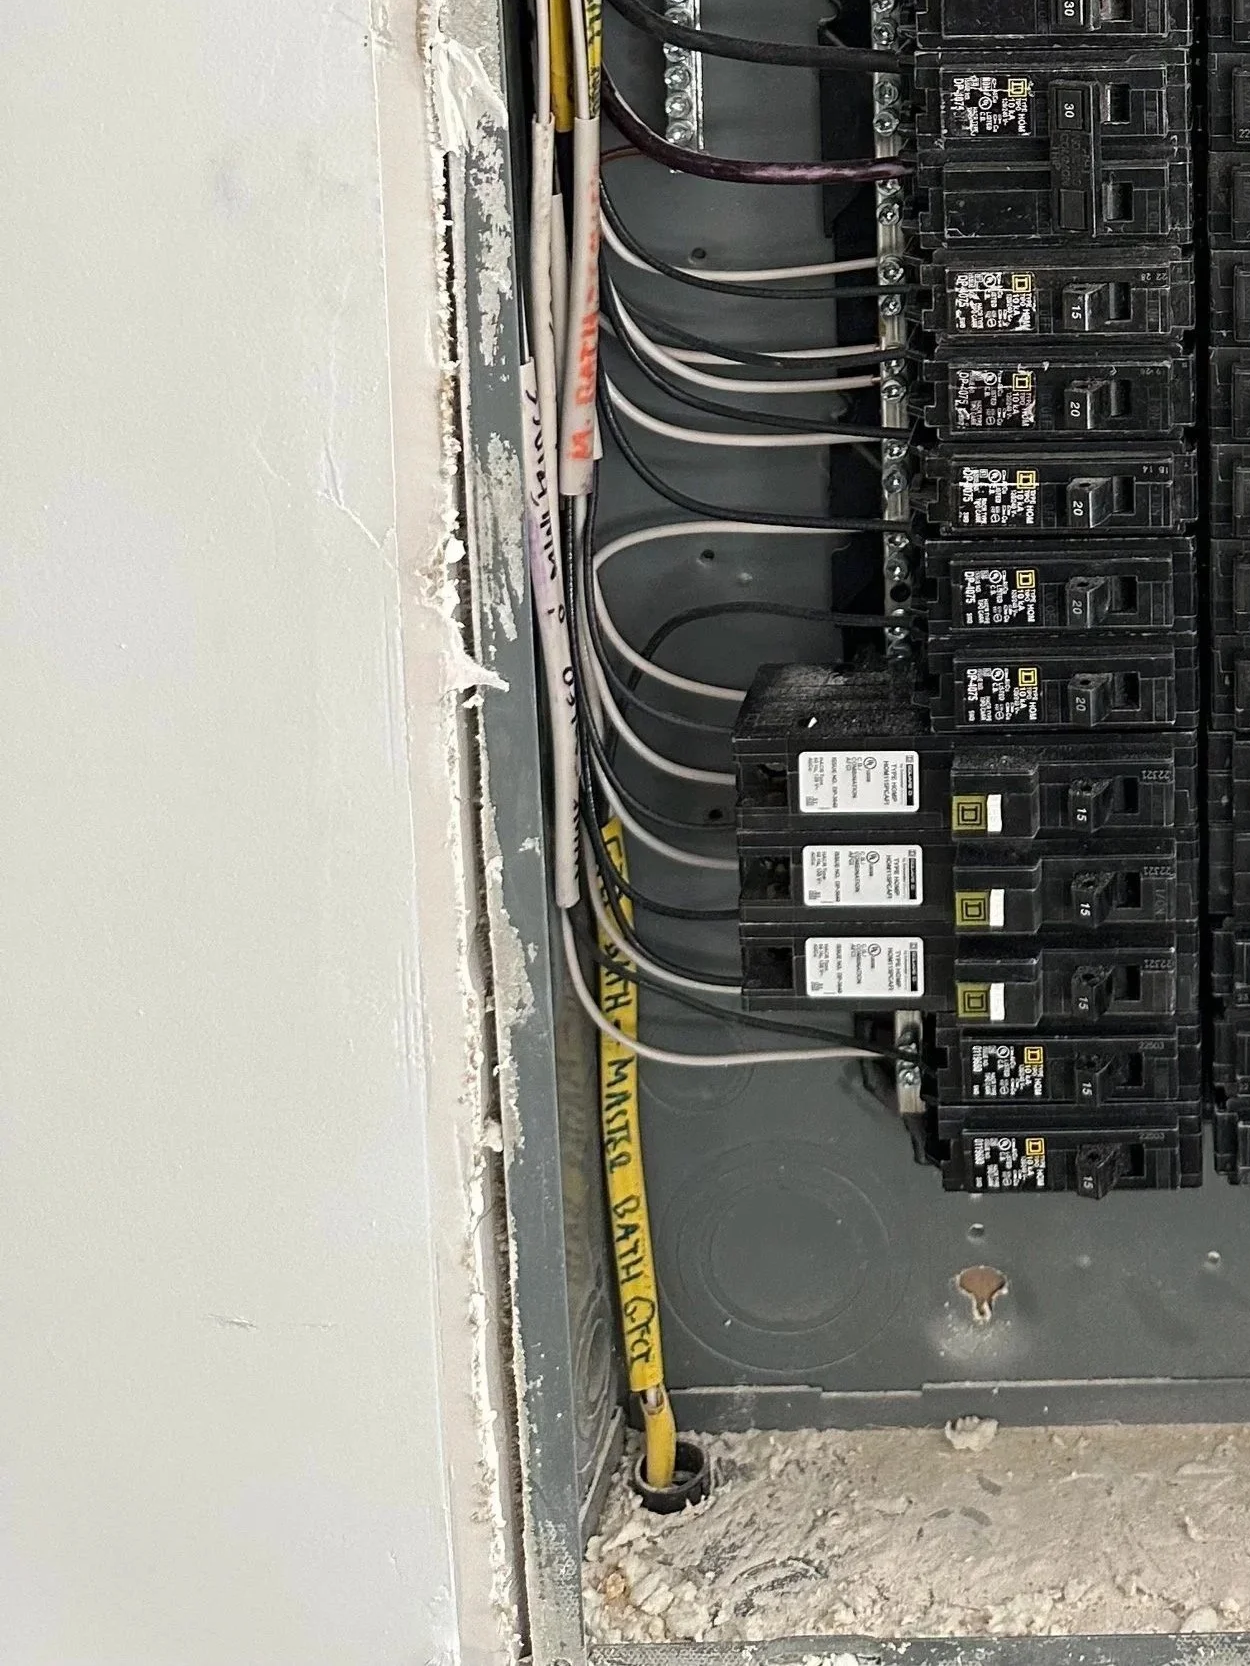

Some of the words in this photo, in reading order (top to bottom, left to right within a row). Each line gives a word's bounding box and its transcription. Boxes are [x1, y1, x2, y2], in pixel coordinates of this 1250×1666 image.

[1064, 1, 1075, 17] 30
[1064, 103, 1075, 118] 30
[1072, 305, 1082, 319] 15
[1070, 402, 1081, 417] 20
[1016, 490, 1024, 499] 10
[1016, 502, 1024, 512] kA
[1073, 500, 1083, 516] 20
[1026, 506, 1034, 524] HOM
[965, 571, 975, 604] DP-4075
[1017, 590, 1025, 600] 10
[1017, 602, 1025, 612] kA
[1027, 604, 1035, 622] HOM
[1072, 600, 1082, 615] 20
[967, 669, 978, 700] DP-4075
[1019, 688, 1027, 697] 10
[1029, 702, 1037, 720] HOM
[1075, 697, 1085, 711] 20
[1076, 808, 1087, 822] 15
[1080, 902, 1090, 917] 15
[1079, 996, 1089, 1011] 15
[1082, 1082, 1092, 1096] 15
[1083, 1176, 1093, 1189] 15
[613, 1194, 644, 1285] BATH
